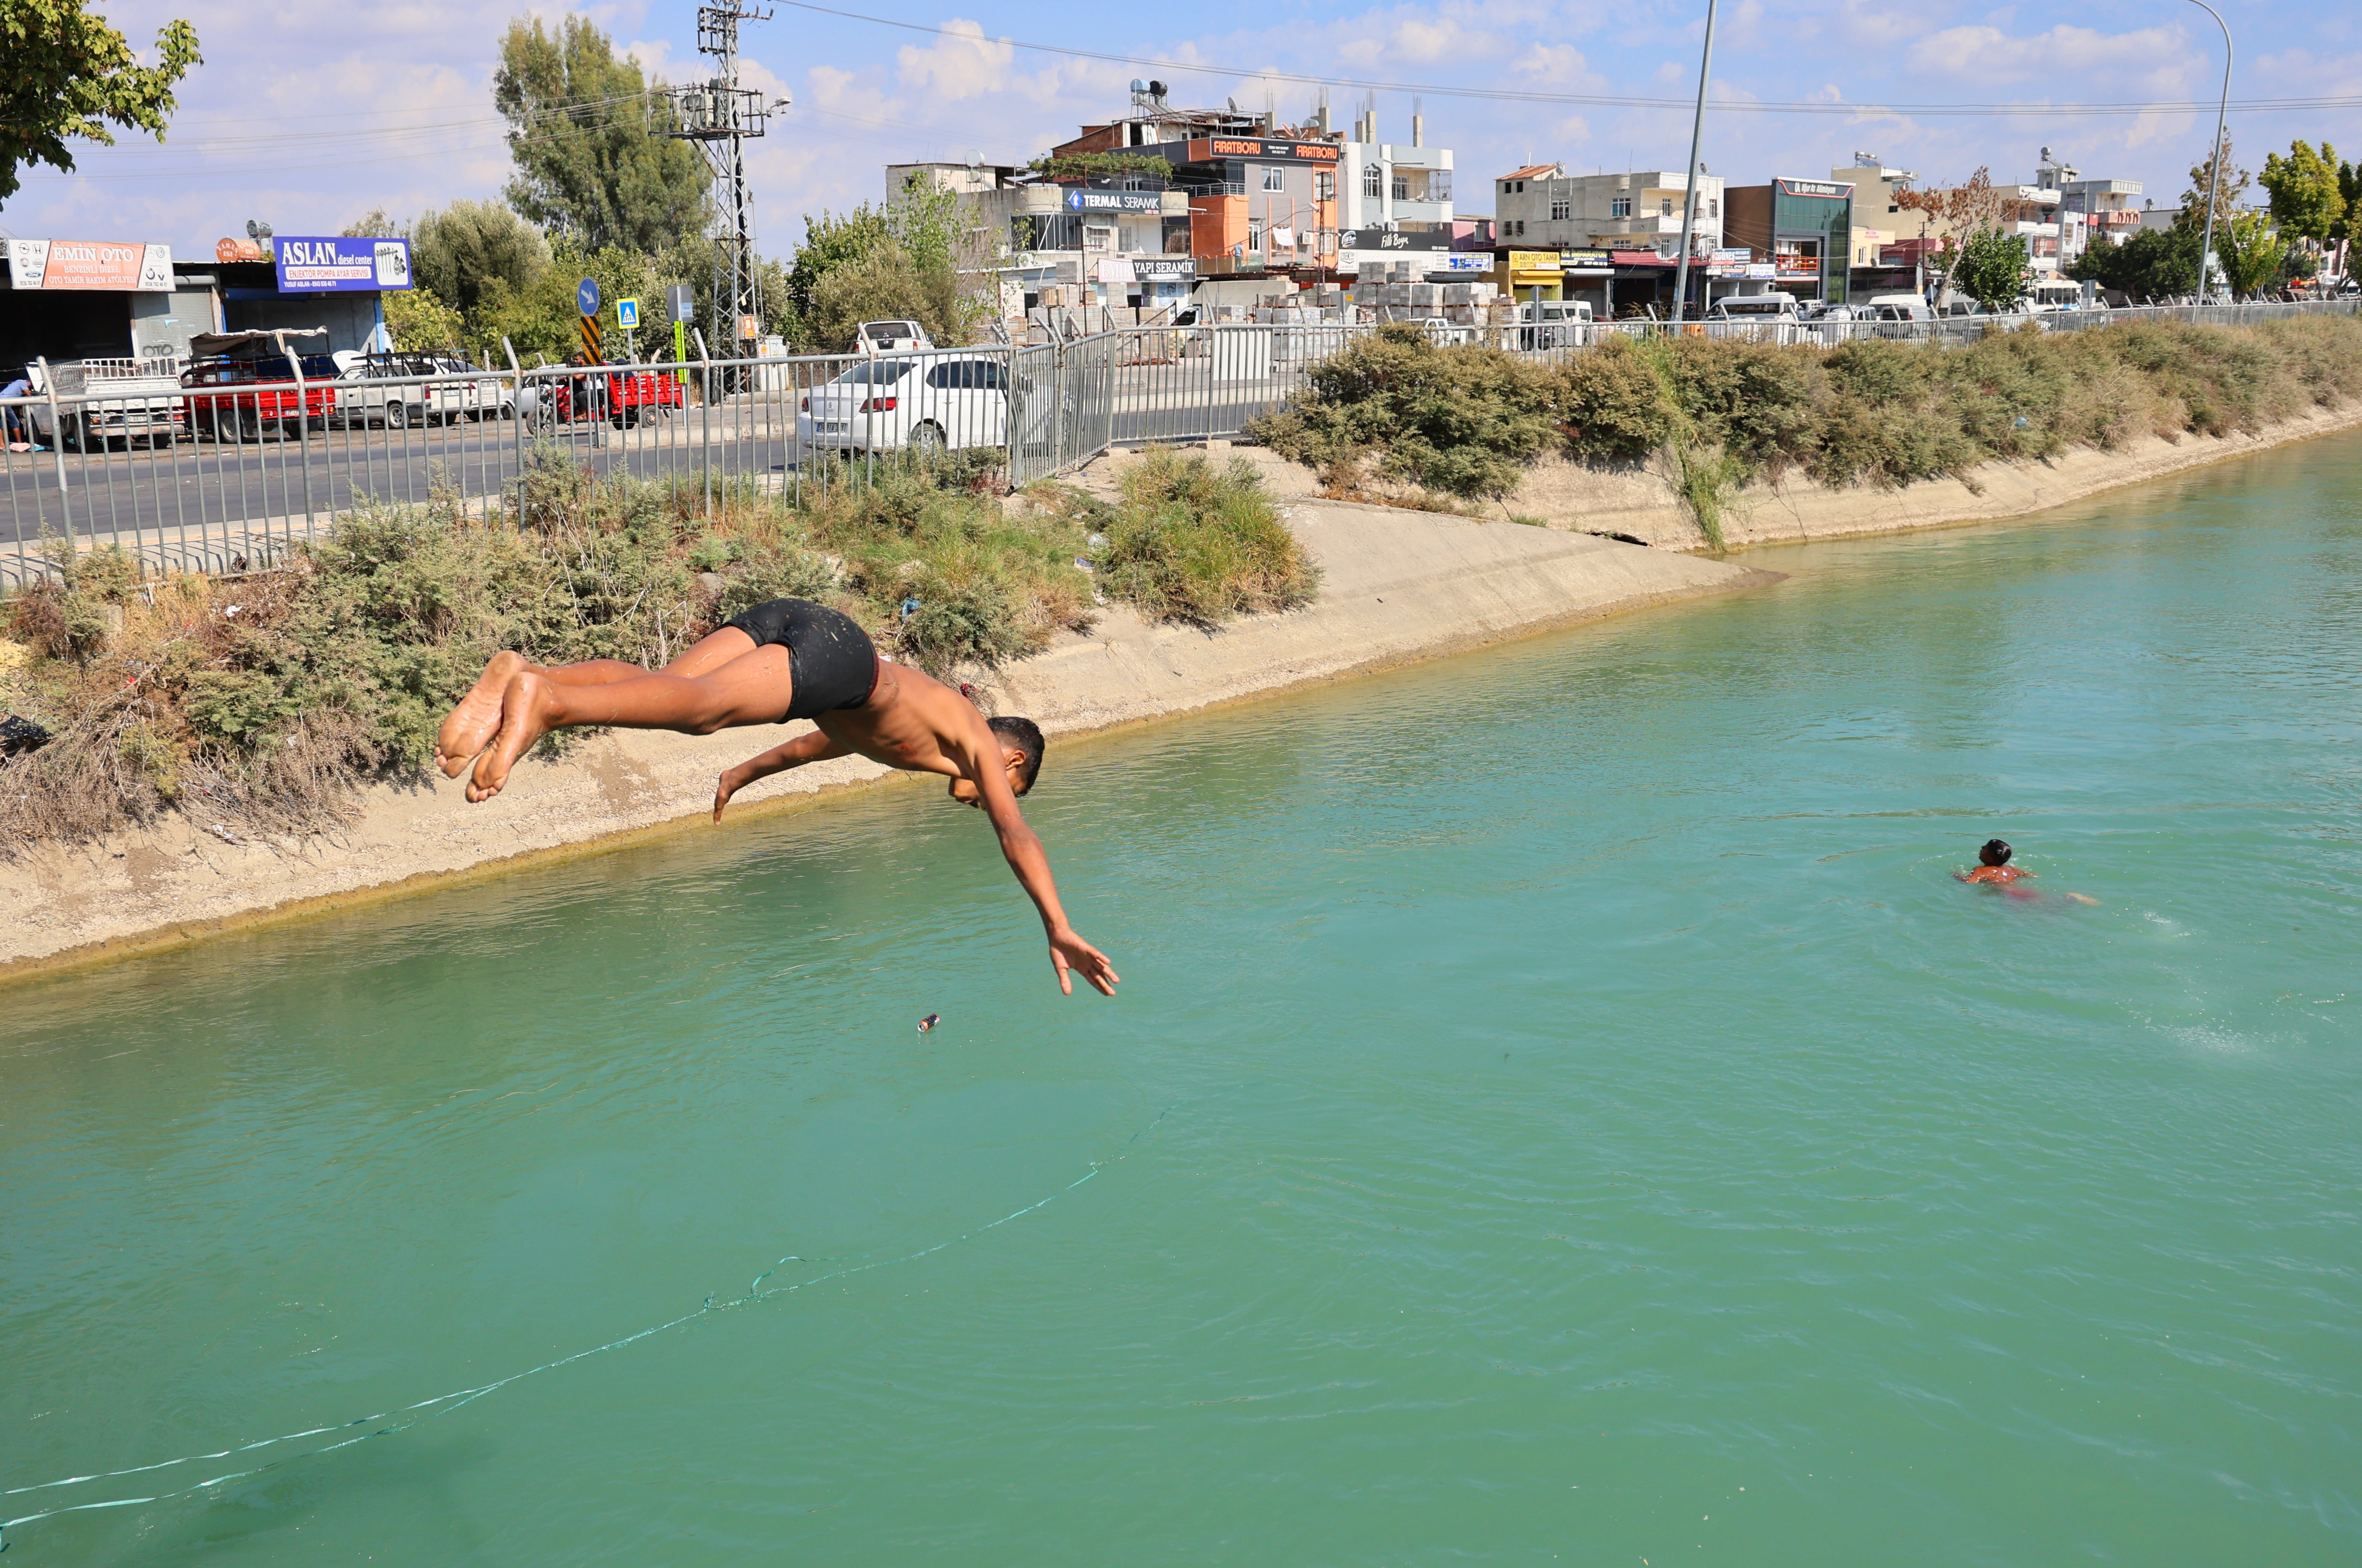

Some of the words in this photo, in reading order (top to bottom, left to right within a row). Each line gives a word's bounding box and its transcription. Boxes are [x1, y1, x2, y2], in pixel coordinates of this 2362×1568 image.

[1214, 141, 1260, 154] FIRATBORU
[1296, 145, 1337, 159] FIRATBORU
[1084, 195, 1121, 208] TERMAL
[1124, 196, 1159, 209] SERAMİK
[1381, 234, 1392, 248] Filli
[1393, 233, 1409, 248] Boya
[52, 243, 97, 261] EMİN
[100, 248, 135, 262] OTO
[282, 242, 337, 265] ASLAN
[338, 254, 354, 265] diesel
[355, 255, 372, 264] center
[64, 263, 98, 274] BENZİNLİ
[99, 264, 120, 273] DİZEL
[289, 268, 316, 278] ENJEKTÖR
[317, 270, 336, 278] POMPA
[351, 268, 368, 277] SERVİSİ
[1102, 262, 1132, 278] EMİR
[1134, 262, 1155, 273] YAPI
[1156, 260, 1194, 273] SERAMİK
[64, 274, 84, 284] TAMİR
[107, 274, 137, 284] ATÖLYESİ
[143, 344, 173, 357] OTO
